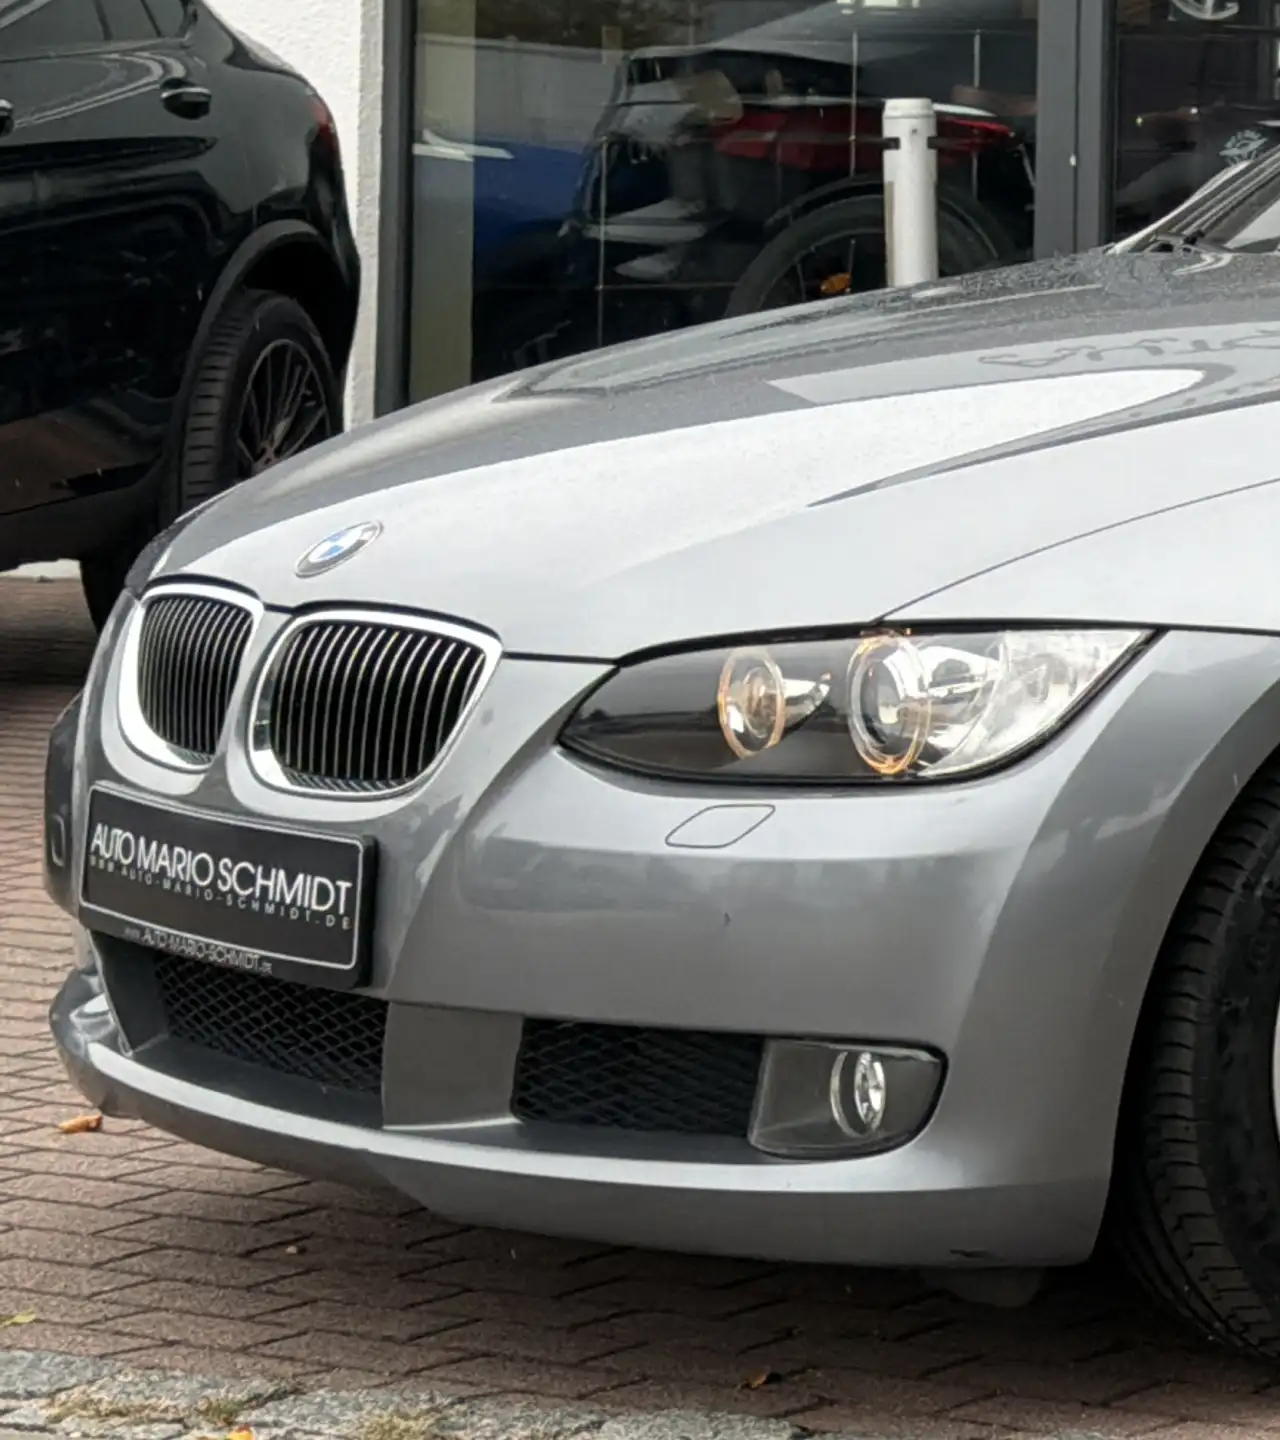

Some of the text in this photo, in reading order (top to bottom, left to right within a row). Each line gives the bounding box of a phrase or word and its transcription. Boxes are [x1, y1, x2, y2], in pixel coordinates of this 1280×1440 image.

[90, 854, 353, 930] AUTO-MARIO-SCHMIDT.DE
[91, 823, 353, 915] AUTO MARIO SCHMIDT
